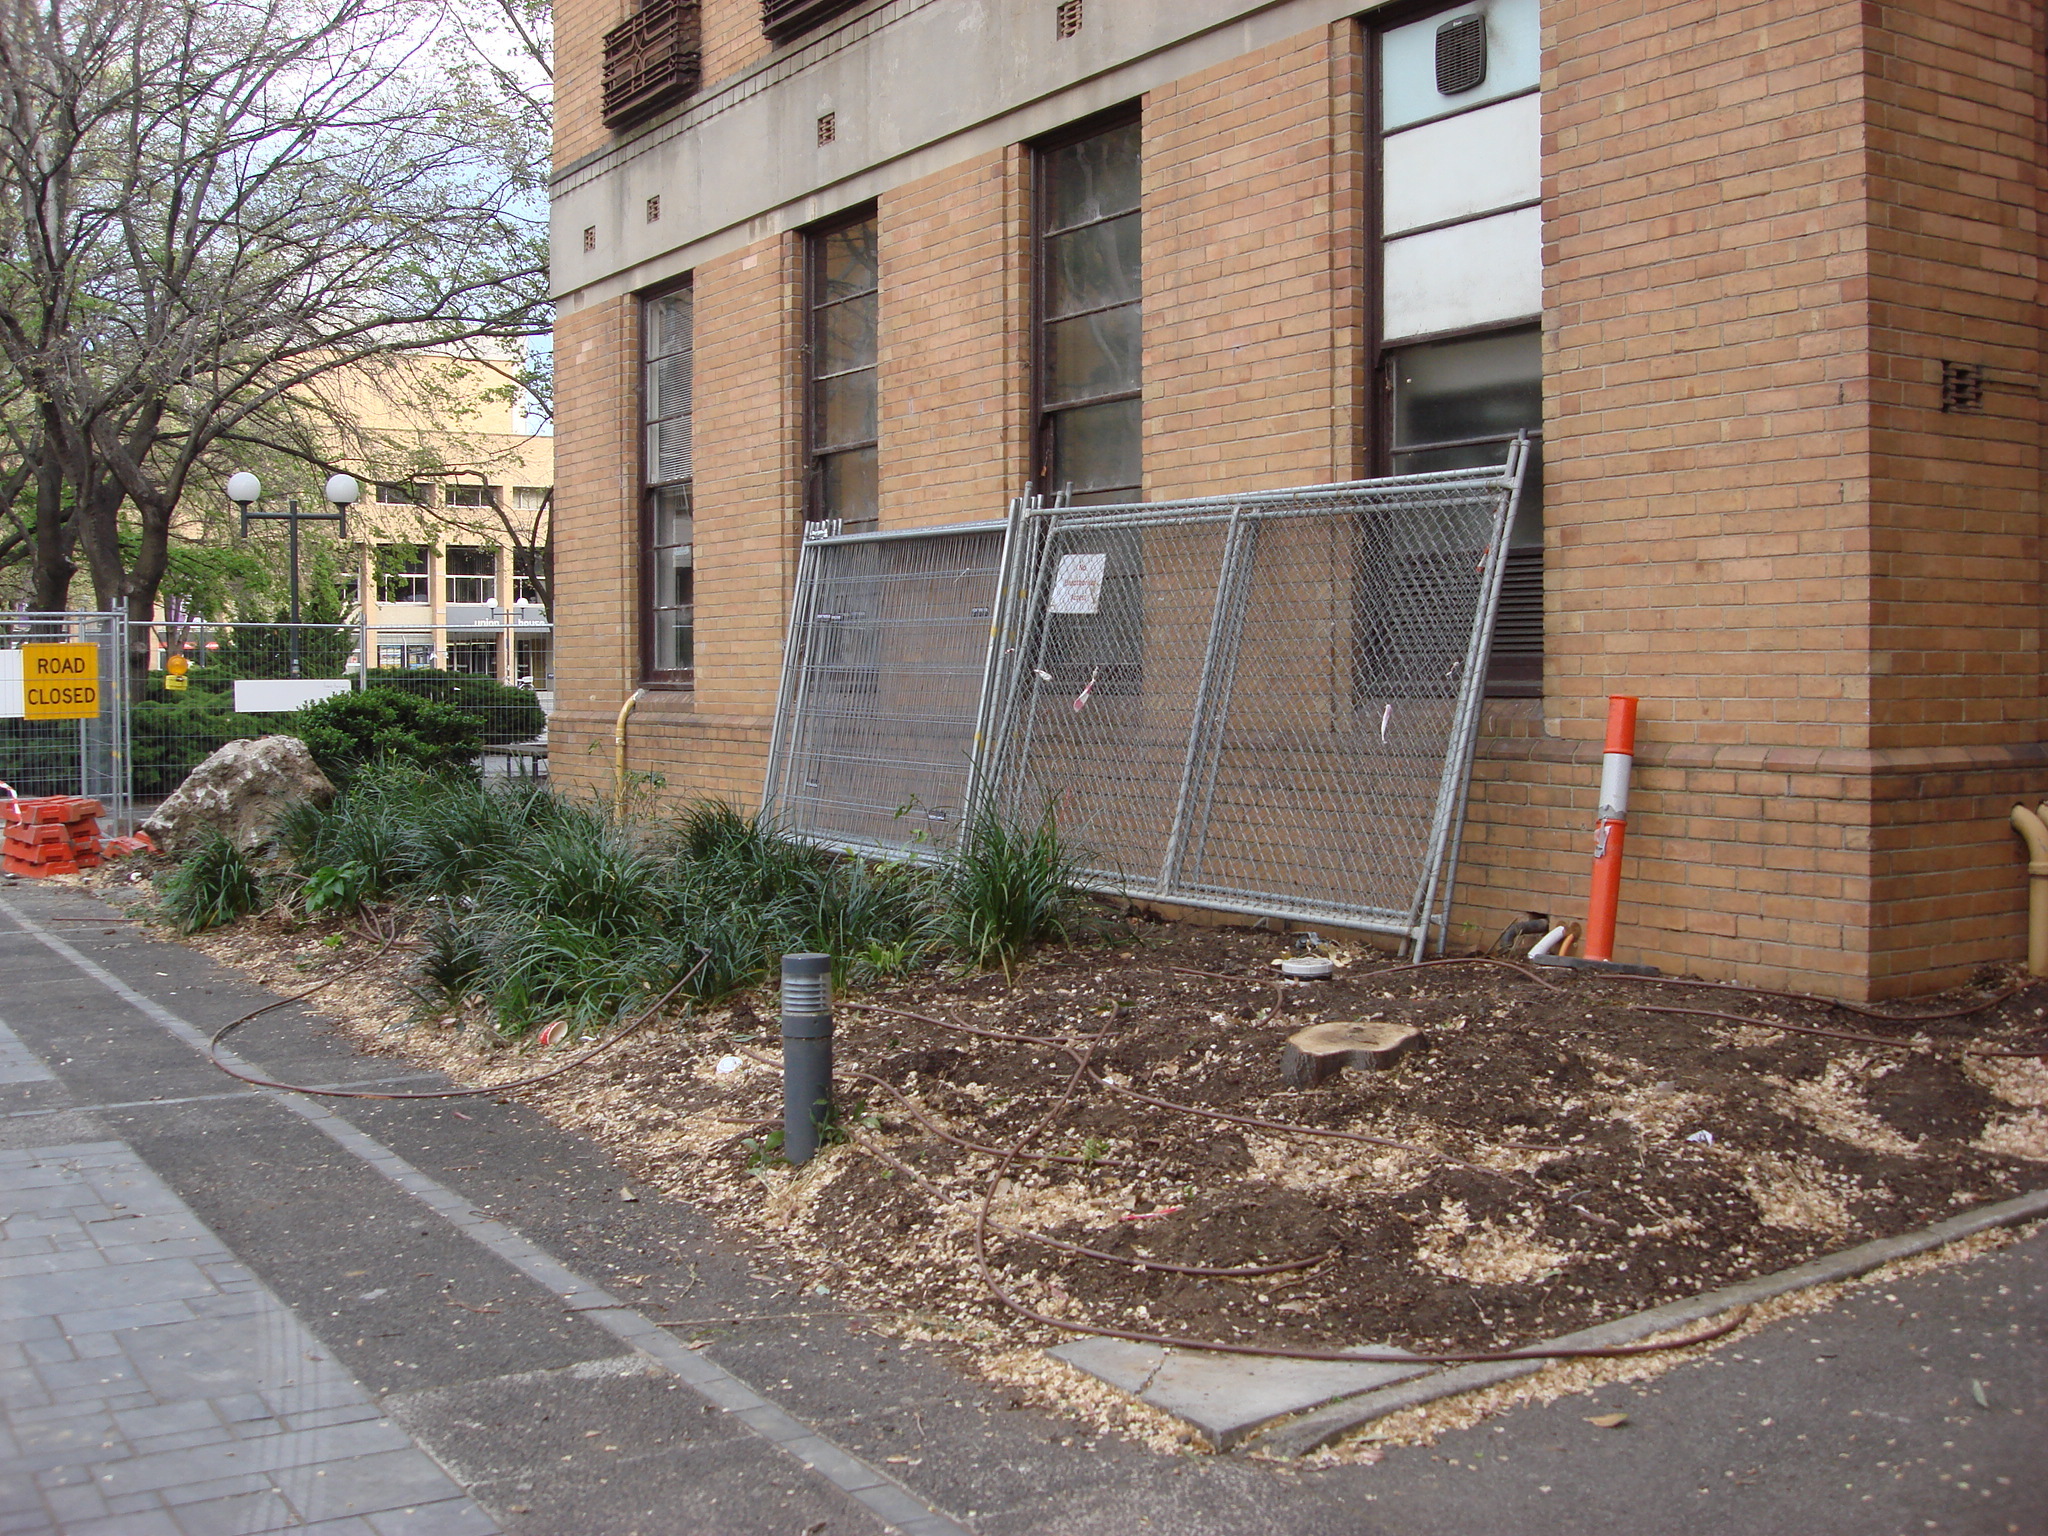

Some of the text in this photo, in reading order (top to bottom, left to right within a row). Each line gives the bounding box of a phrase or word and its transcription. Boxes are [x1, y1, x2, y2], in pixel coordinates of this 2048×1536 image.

[474, 618, 500, 626] union
[38, 657, 85, 674] ROAD
[28, 687, 96, 705] CLOSED
